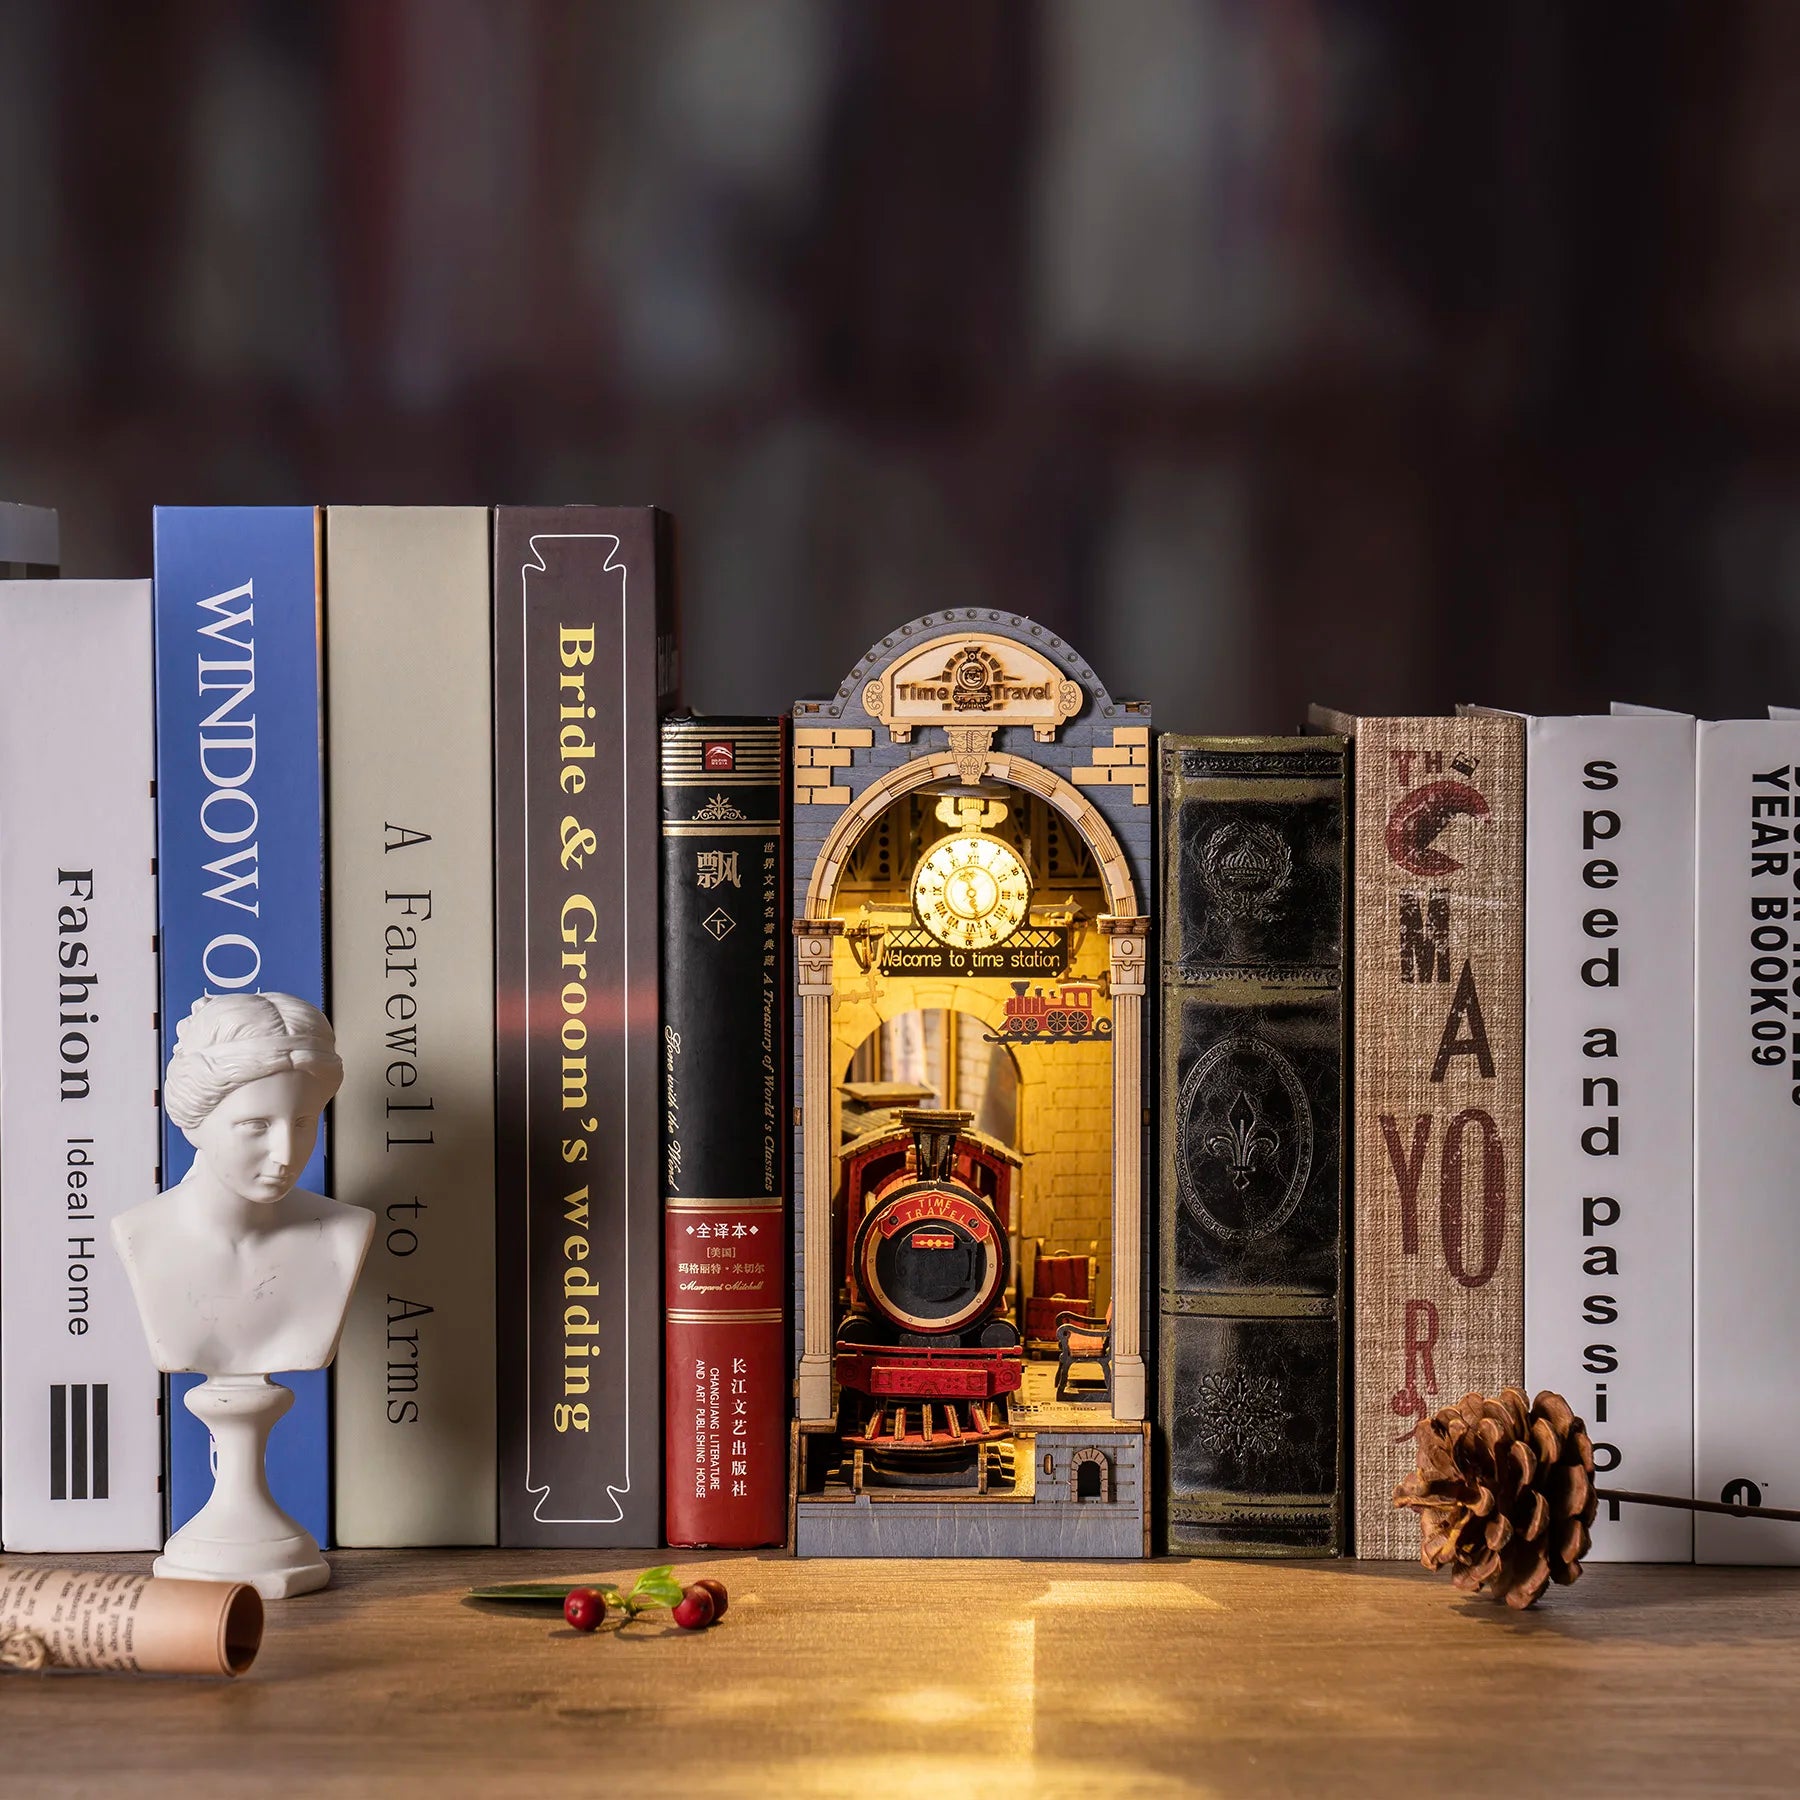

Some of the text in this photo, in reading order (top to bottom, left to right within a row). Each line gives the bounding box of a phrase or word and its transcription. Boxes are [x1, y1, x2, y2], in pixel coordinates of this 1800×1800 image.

[896, 682, 1053, 701] Time Travel
[196, 577, 261, 997] WINDOW O
[1390, 750, 1481, 786] THE
[1751, 764, 1791, 878] YEAR
[696, 849, 742, 889] 飘
[1011, 867, 1019, 876] 10
[1017, 892, 1025, 901] 15
[1580, 760, 1622, 988] speed
[710, 919, 727, 935] 下
[965, 939, 973, 947] 30
[57, 867, 99, 1103] Fashion
[882, 950, 1060, 967] Welcome to time station
[553, 623, 601, 1434] Bride & Groom's wedding
[762, 990, 774, 1051] Treasury
[762, 1054, 773, 1075] of
[1580, 1028, 1622, 1157] and
[384, 821, 435, 1424] A Farewell to Arms
[665, 1025, 682, 1192] Gone with the Wind
[764, 1075, 775, 1132] World's
[764, 1135, 775, 1192] Classics
[696, 1222, 748, 1239] 全译本
[906, 1207, 965, 1223] TRAVEL
[918, 1198, 952, 1209] TIME
[66, 1138, 95, 1336] Ideal Home
[680, 1280, 764, 1294] Margaret Mitchell
[695, 1359, 707, 1499] AND ART PUBLISHING HOUSE
[709, 1367, 720, 1491] CHANGJIANG LITERATURE
[730, 1357, 748, 1498] 长江文艺出版社
